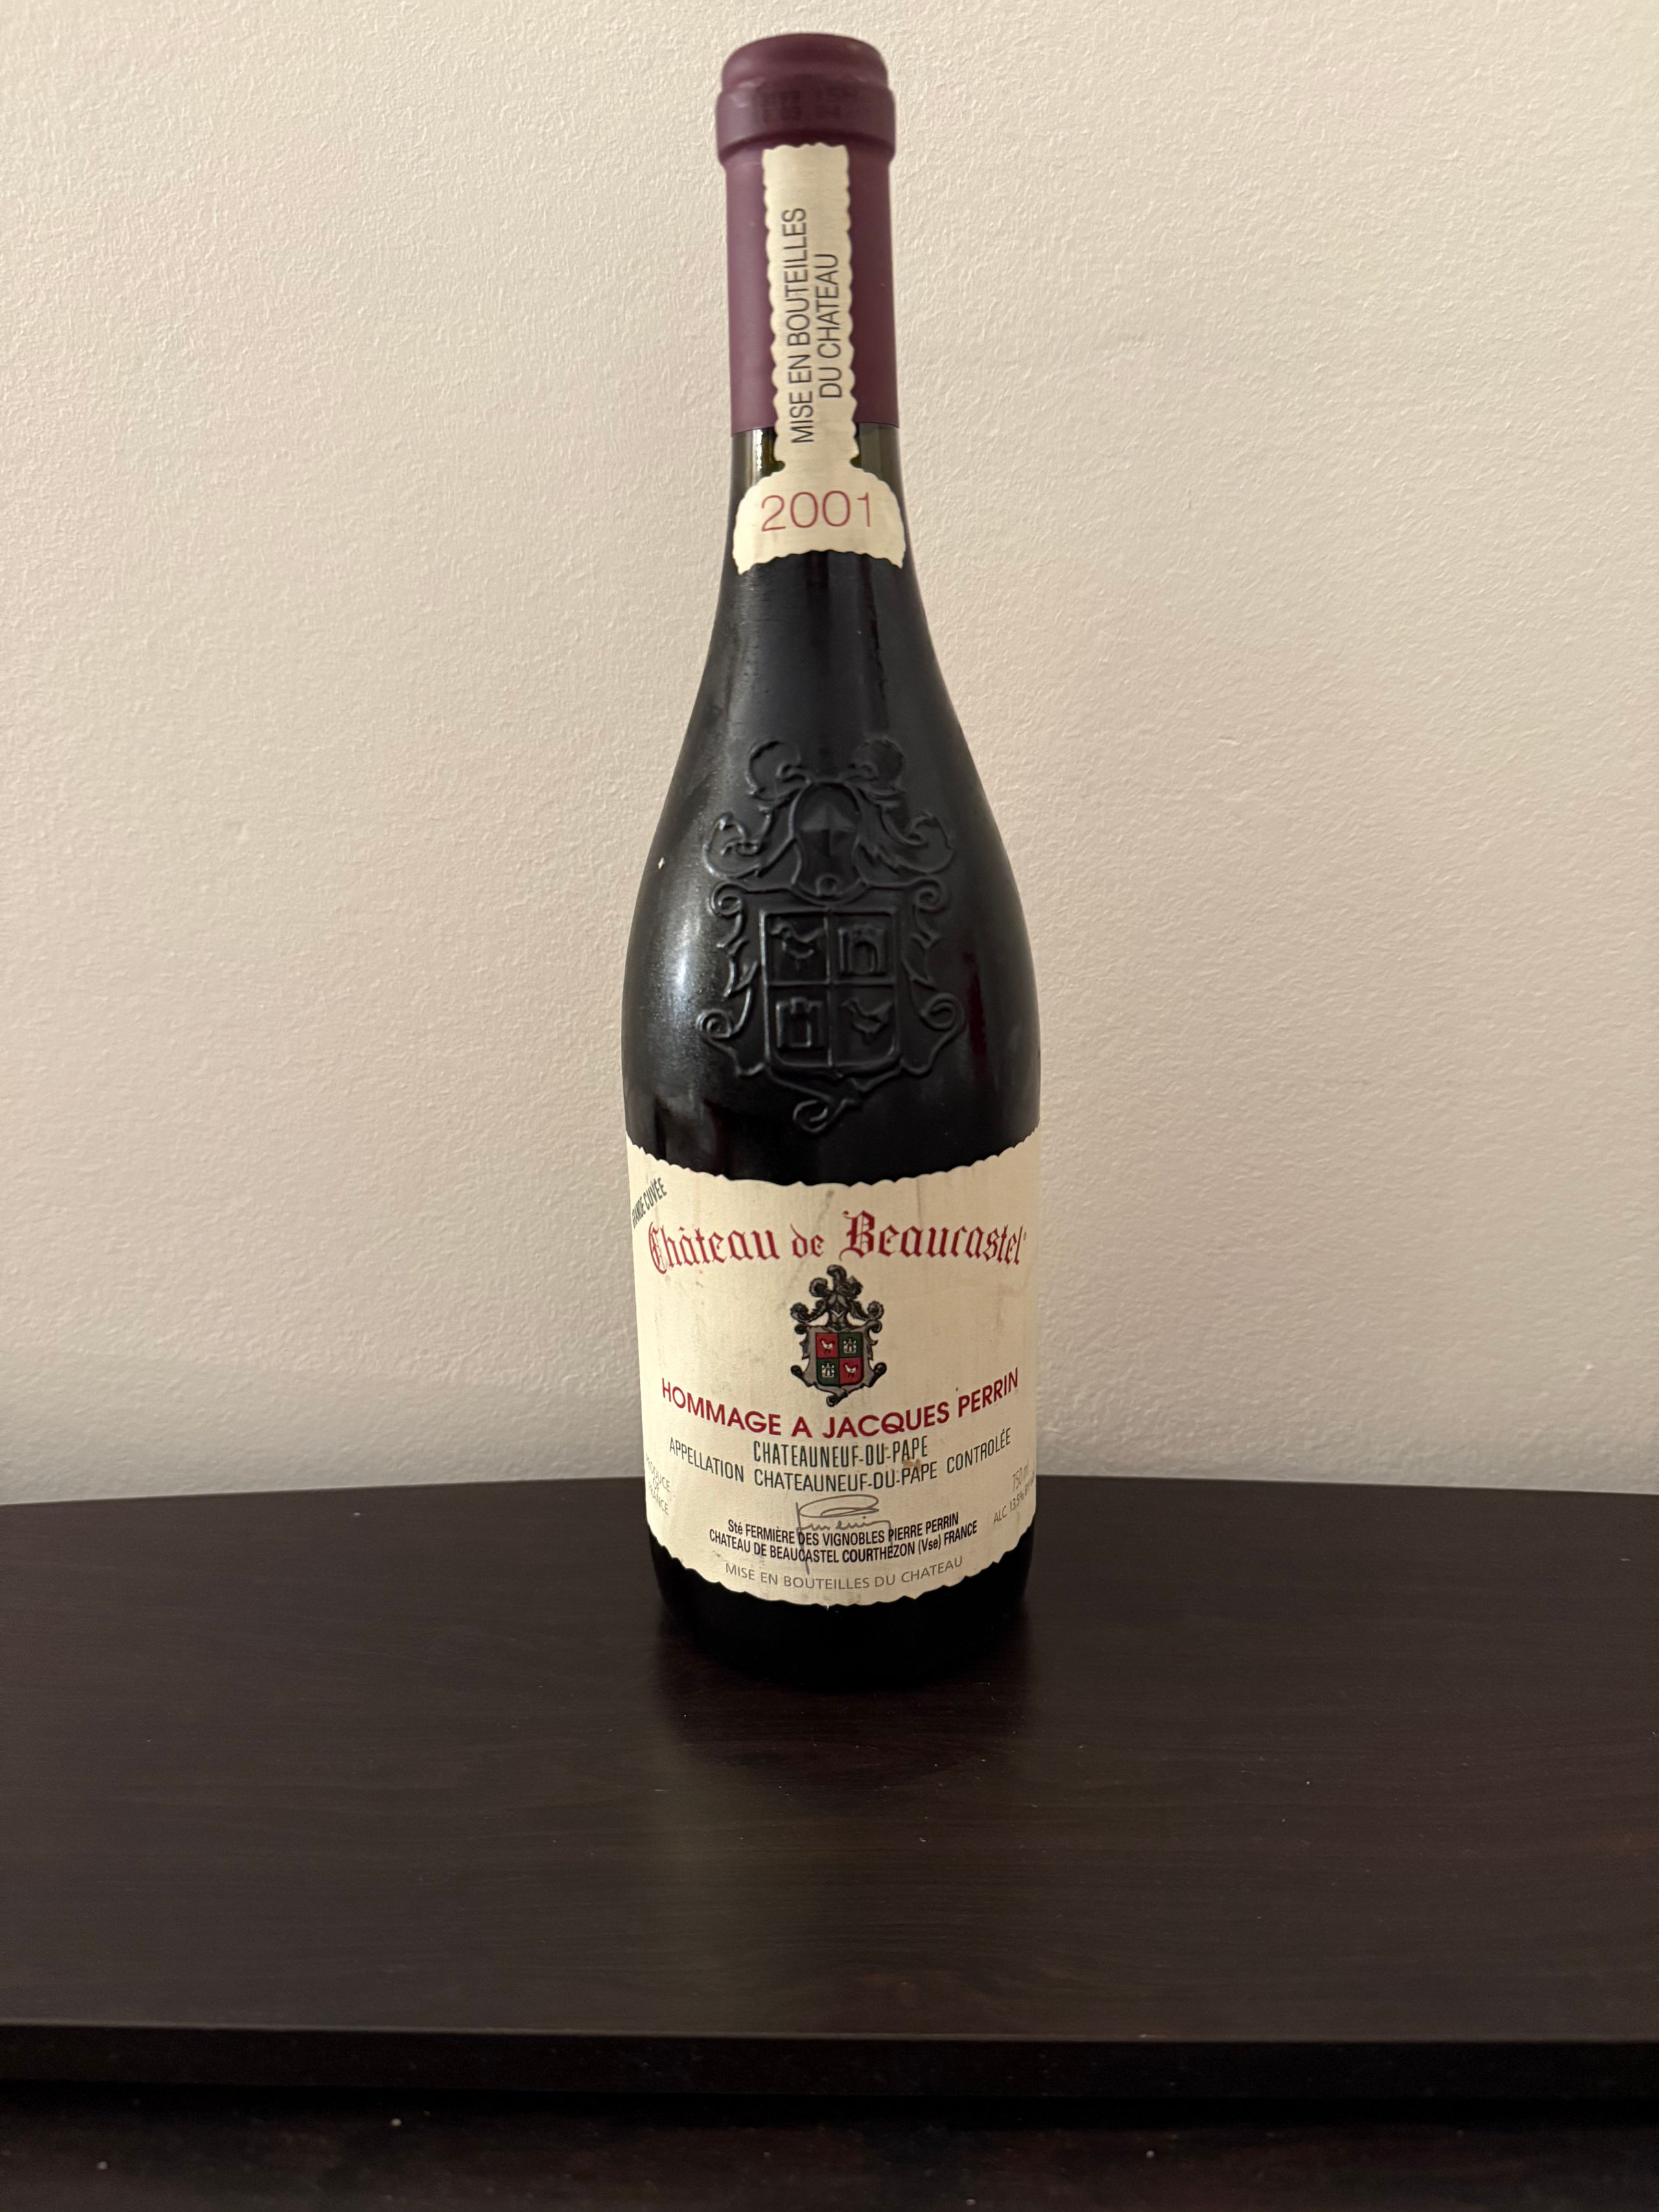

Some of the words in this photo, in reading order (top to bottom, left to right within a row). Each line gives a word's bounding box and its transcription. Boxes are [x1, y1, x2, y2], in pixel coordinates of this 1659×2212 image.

[782, 207, 811, 347] BOUTEILLES
[814, 253, 841, 358] CHATEAU
[787, 354, 811, 384] EN
[818, 367, 842, 398] DU
[789, 390, 814, 443] MISE
[761, 490, 872, 532] 2001
[648, 1221, 781, 1274] Château
[789, 1223, 825, 1259] de
[839, 1210, 1024, 1265] Beaucastel
[662, 1377, 782, 1436] HOMMAGE
[791, 1416, 813, 1438] A
[822, 1401, 949, 1439] JACQUES
[958, 1366, 1018, 1418] PERRIN
[669, 1437, 745, 1483] APPELLATION
[754, 1461, 938, 1492] CHATEAUNEUF-DU-PAPE
[946, 1427, 1011, 1474] CONTROLÉE
[753, 1435, 929, 1468] CHATEAUNEUF-DU-PAPE
[710, 1528, 750, 1553] CHATEAU
[754, 1542, 767, 1557] DE
[770, 1545, 839, 1563] BEAUCASTEL
[918, 1533, 941, 1555] (Vse)
[944, 1520, 977, 1546] FRANCE
[728, 1519, 743, 1535] Sté
[745, 1523, 795, 1544] FERMIÈRE
[798, 1531, 819, 1546] DES
[822, 1530, 885, 1546] VIGNOBLES
[888, 1523, 923, 1542] PIERRE
[925, 1511, 958, 1534] PERRIN
[725, 1563, 755, 1580] MISE
[760, 1572, 778, 1585] EN
[783, 1576, 870, 1590] BOUTEILLES
[875, 1574, 896, 1587] DU
[901, 1555, 963, 1583] CHATEAU
